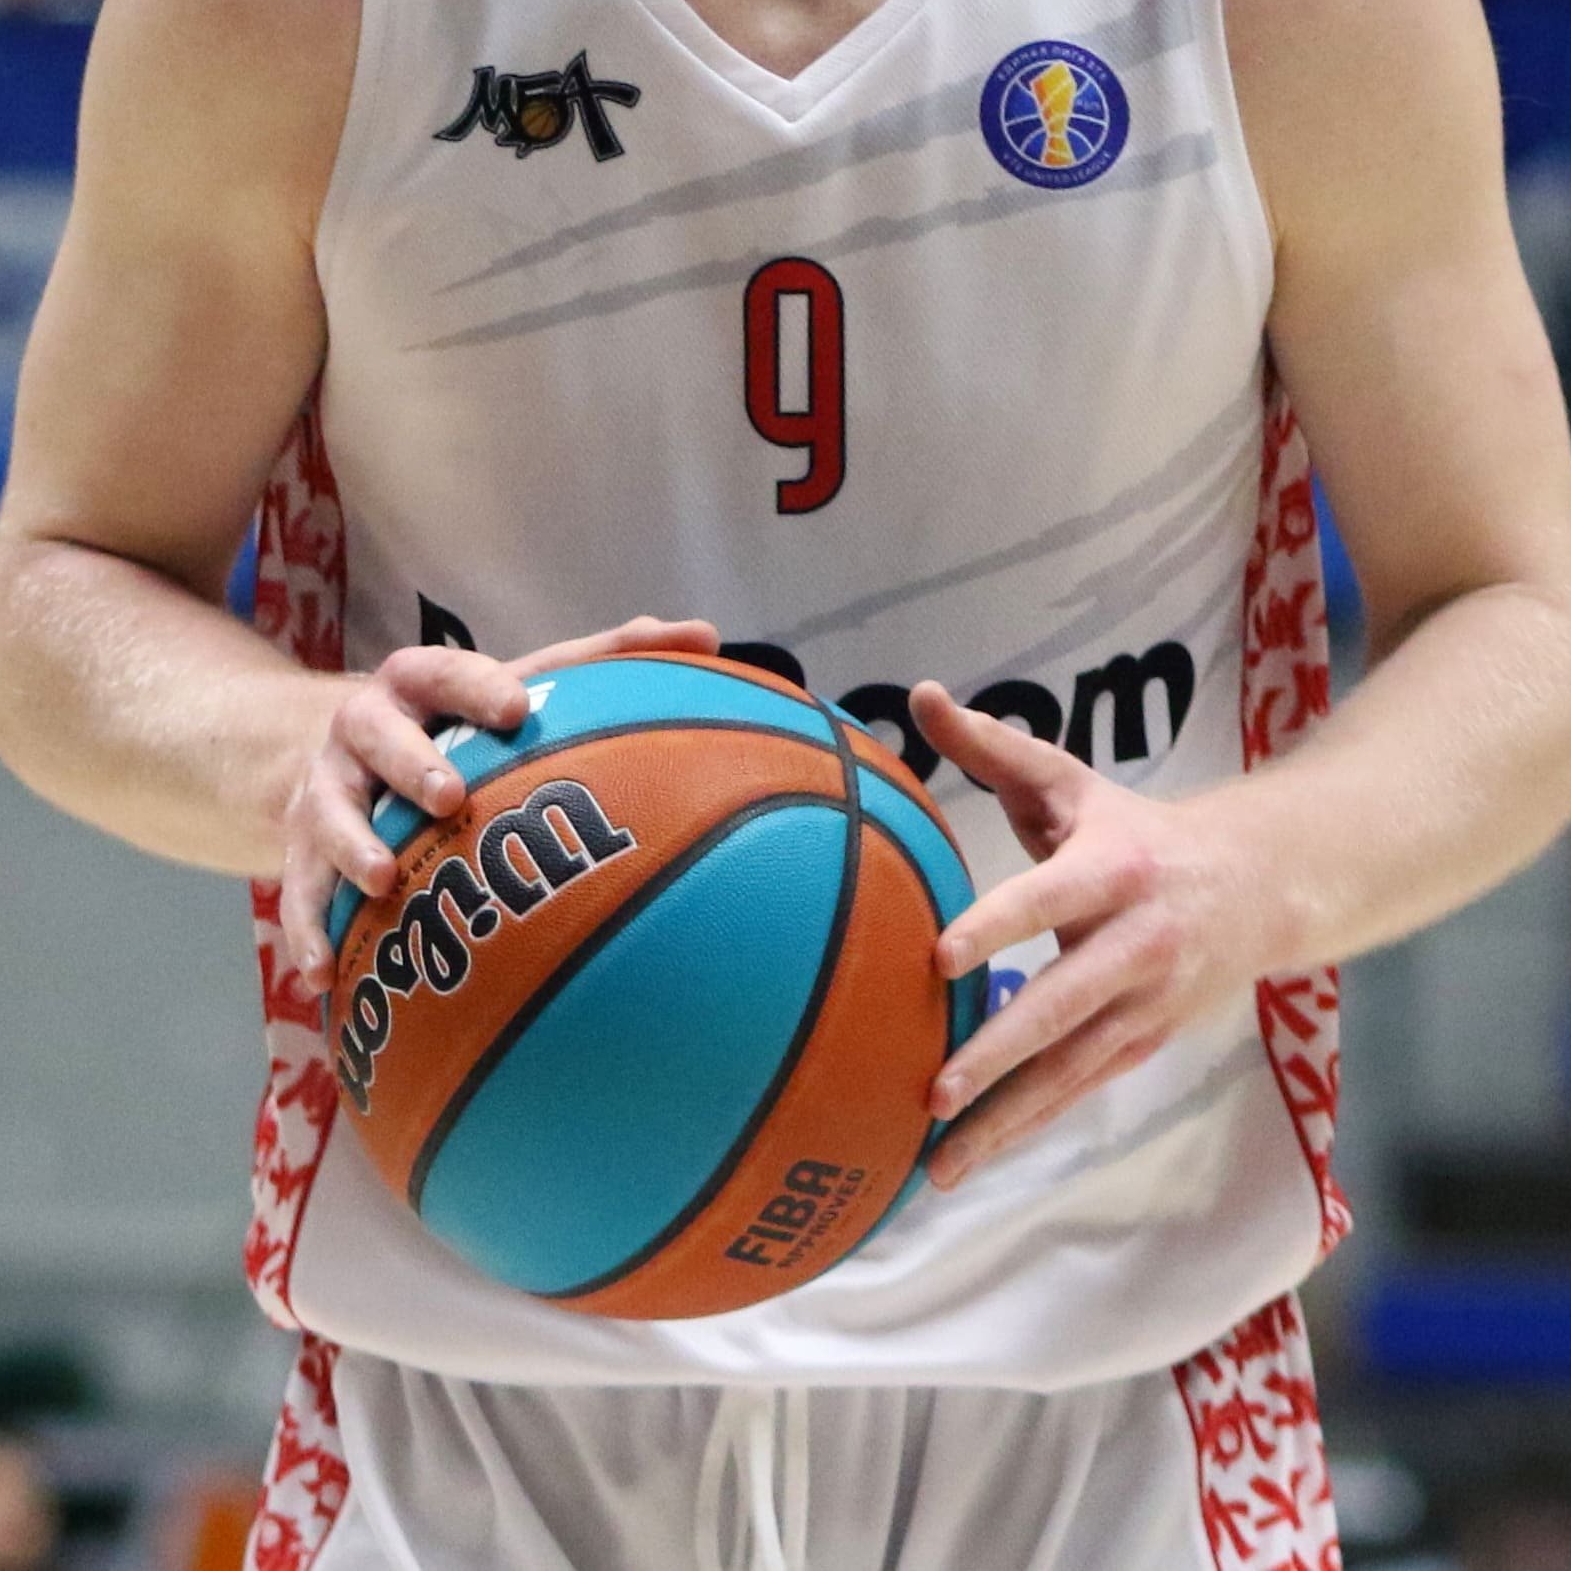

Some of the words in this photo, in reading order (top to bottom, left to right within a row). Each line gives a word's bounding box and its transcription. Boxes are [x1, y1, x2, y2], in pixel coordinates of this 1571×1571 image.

[740, 254, 847, 515] 9
[336, 779, 639, 1118] Wilson
[725, 1159, 843, 1266] FIBA
[776, 1167, 866, 1269] APPROVED
